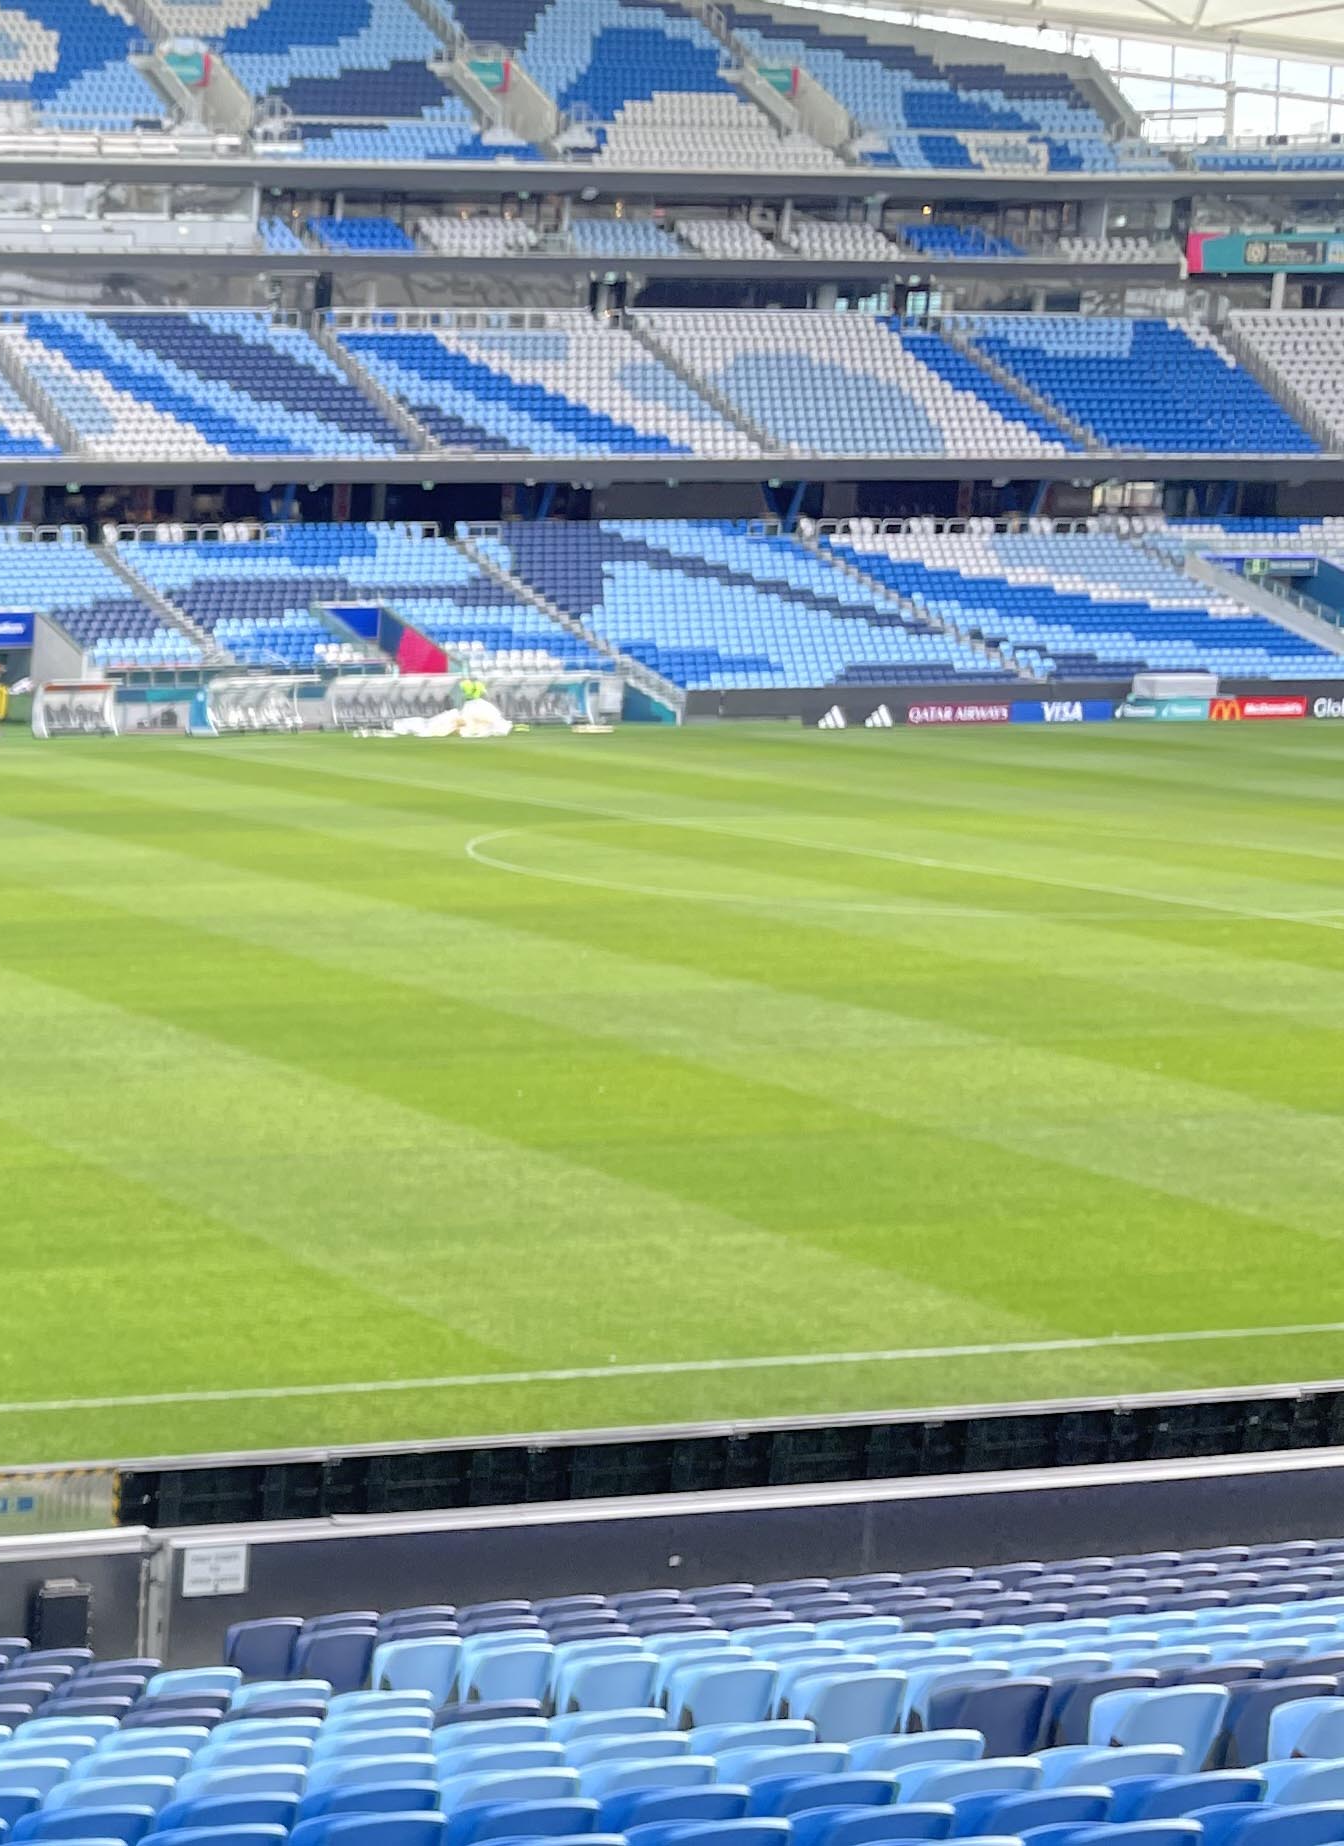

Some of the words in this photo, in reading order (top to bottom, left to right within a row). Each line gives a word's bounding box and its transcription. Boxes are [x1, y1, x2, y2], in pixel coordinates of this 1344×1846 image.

[908, 705, 954, 723] QATAR
[954, 704, 1009, 721] AIRWAYS
[1040, 701, 1083, 723] VISA
